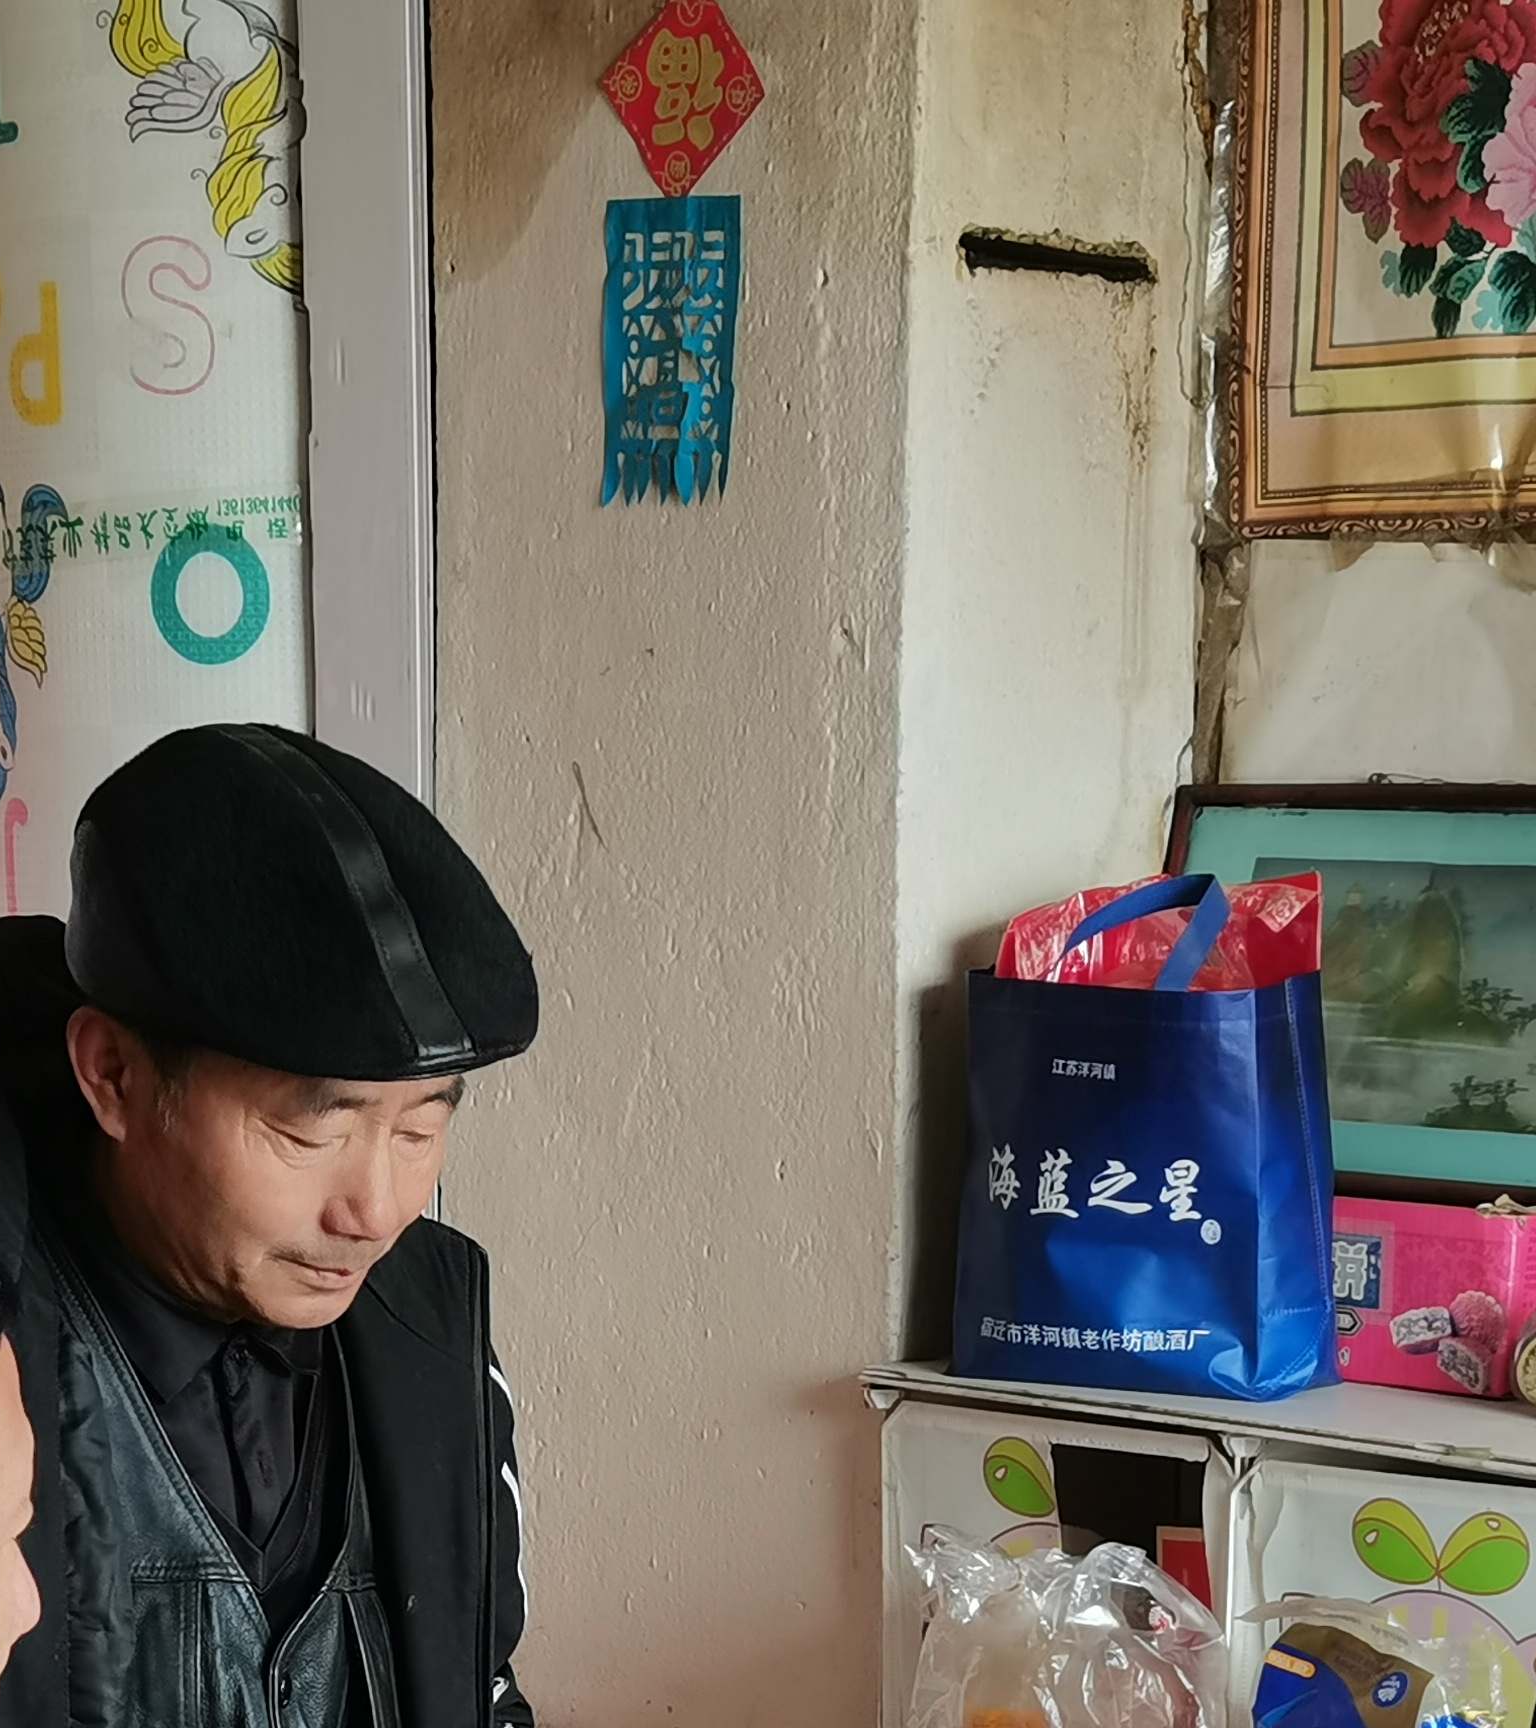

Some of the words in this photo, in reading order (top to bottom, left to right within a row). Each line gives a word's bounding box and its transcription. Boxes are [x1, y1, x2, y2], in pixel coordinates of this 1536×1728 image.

[988, 1143, 1203, 1221] 海蓝之星
[980, 1316, 1211, 1352] 宿迁市洋河镇老作坊酿酒厂
